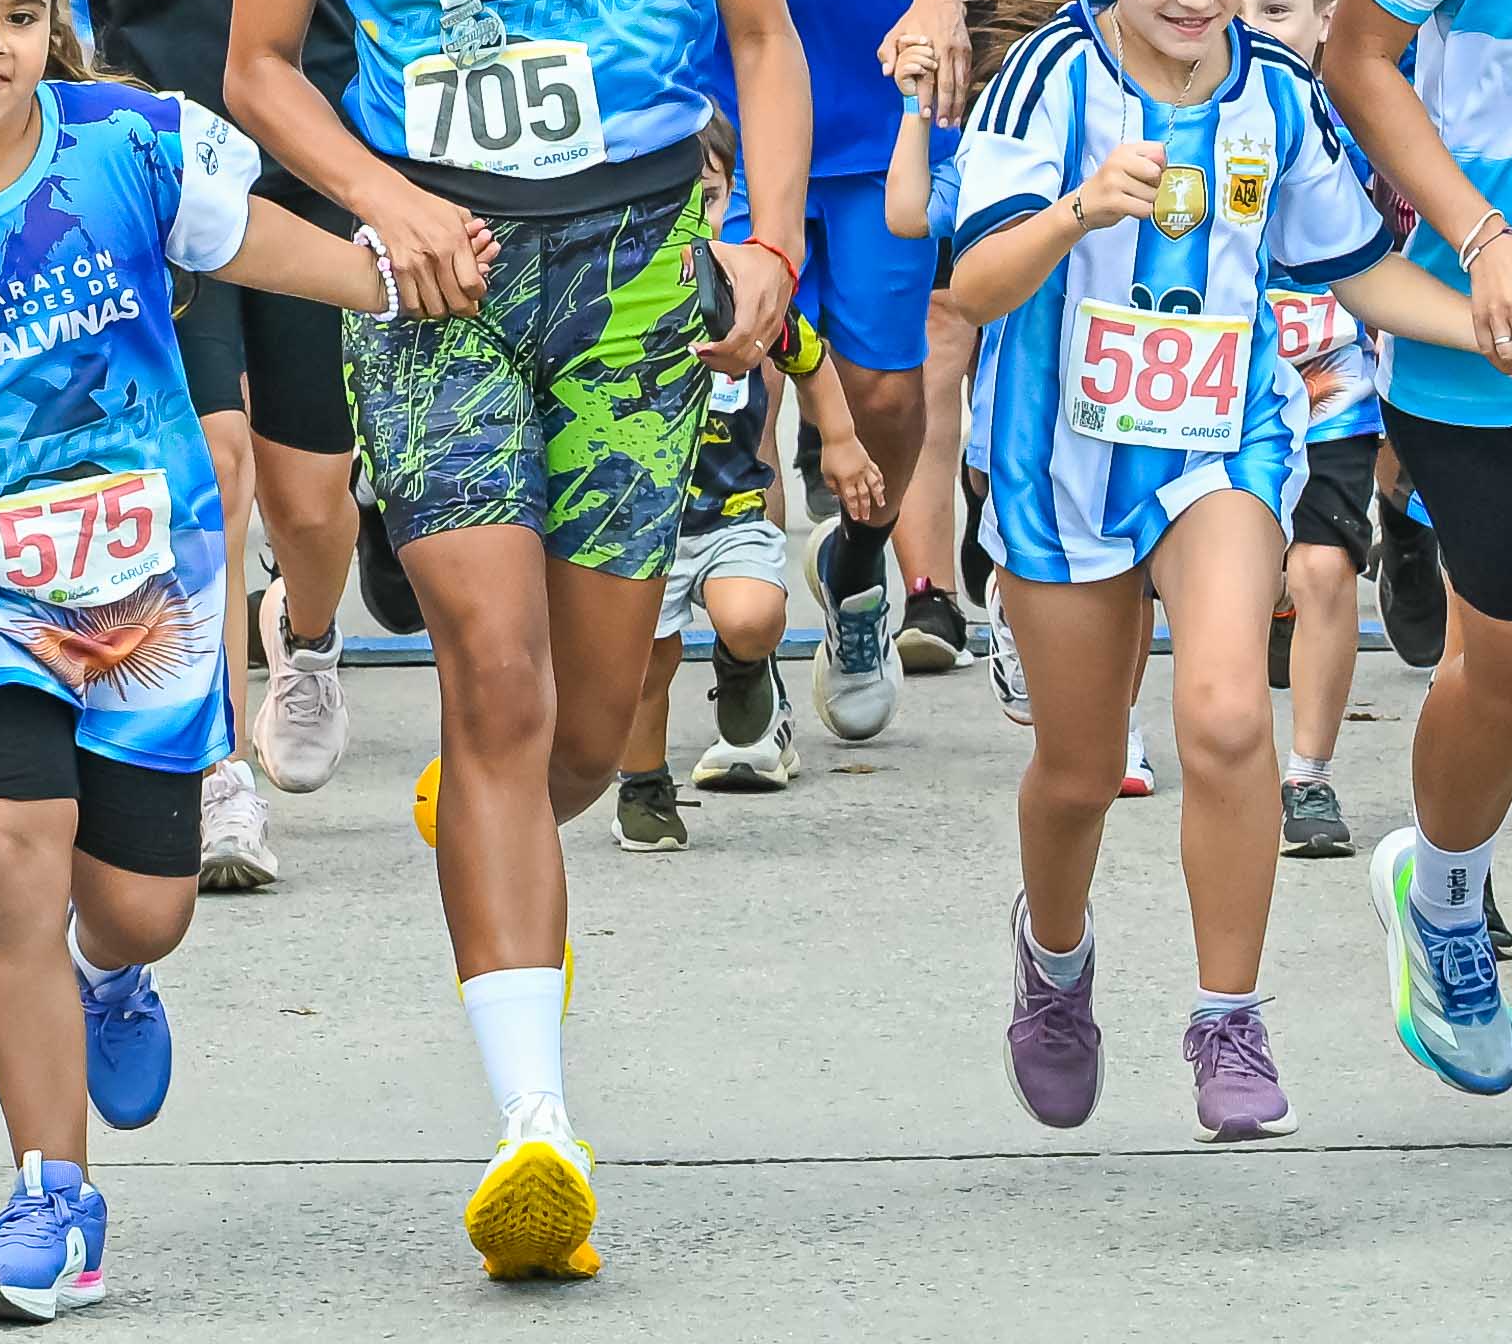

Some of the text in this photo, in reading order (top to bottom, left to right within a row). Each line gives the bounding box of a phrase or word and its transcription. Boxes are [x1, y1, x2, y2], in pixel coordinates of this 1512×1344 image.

[414, 55, 582, 158] 705
[534, 147, 588, 167] CARUSO
[87, 271, 120, 296] DE
[1080, 315, 1239, 416] 584
[1181, 426, 1231, 439] CARUSO
[110, 558, 160, 585] CARUSO
